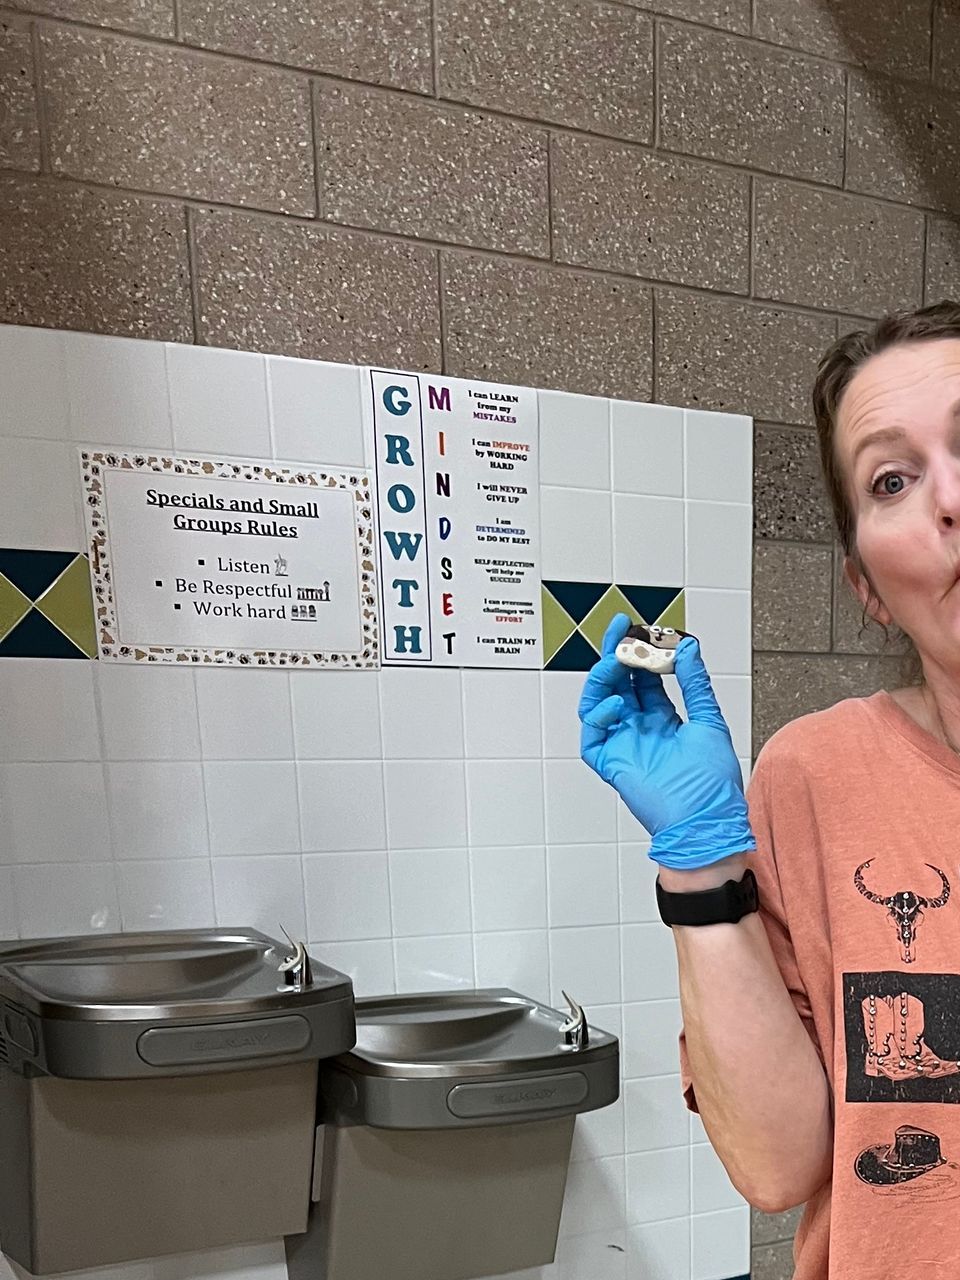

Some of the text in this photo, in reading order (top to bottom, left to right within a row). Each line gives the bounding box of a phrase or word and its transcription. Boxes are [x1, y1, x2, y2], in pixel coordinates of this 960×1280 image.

[468, 390, 519, 402] I can LEARN
[477, 402, 511, 413] from my
[473, 412, 517, 424] MISTAKES
[472, 438, 530, 452] I can IMPROVE
[475, 449, 528, 462] by WORKING
[490, 461, 514, 470] HARD
[482, 484, 498, 492] will
[500, 485, 528, 495] NEVER
[146, 488, 319, 518] Specials and Small
[486, 494, 519, 504] GIVE UP
[382, 385, 424, 654] GROWTH
[428, 385, 456, 655] MINDSET
[173, 514, 298, 538] Groups Rules
[476, 525, 526, 536] DETERMINED
[499, 536, 511, 544] MY
[512, 536, 530, 545] BEST
[217, 557, 270, 574] Listen
[175, 578, 292, 600] Be Respectful
[193, 601, 286, 620] Work hard
[518, 607, 535, 616] with
[495, 616, 523, 624] EFFORT
[497, 637, 523, 646] TRAIN
[524, 638, 537, 646] MY
[494, 646, 521, 654] BRAIN
